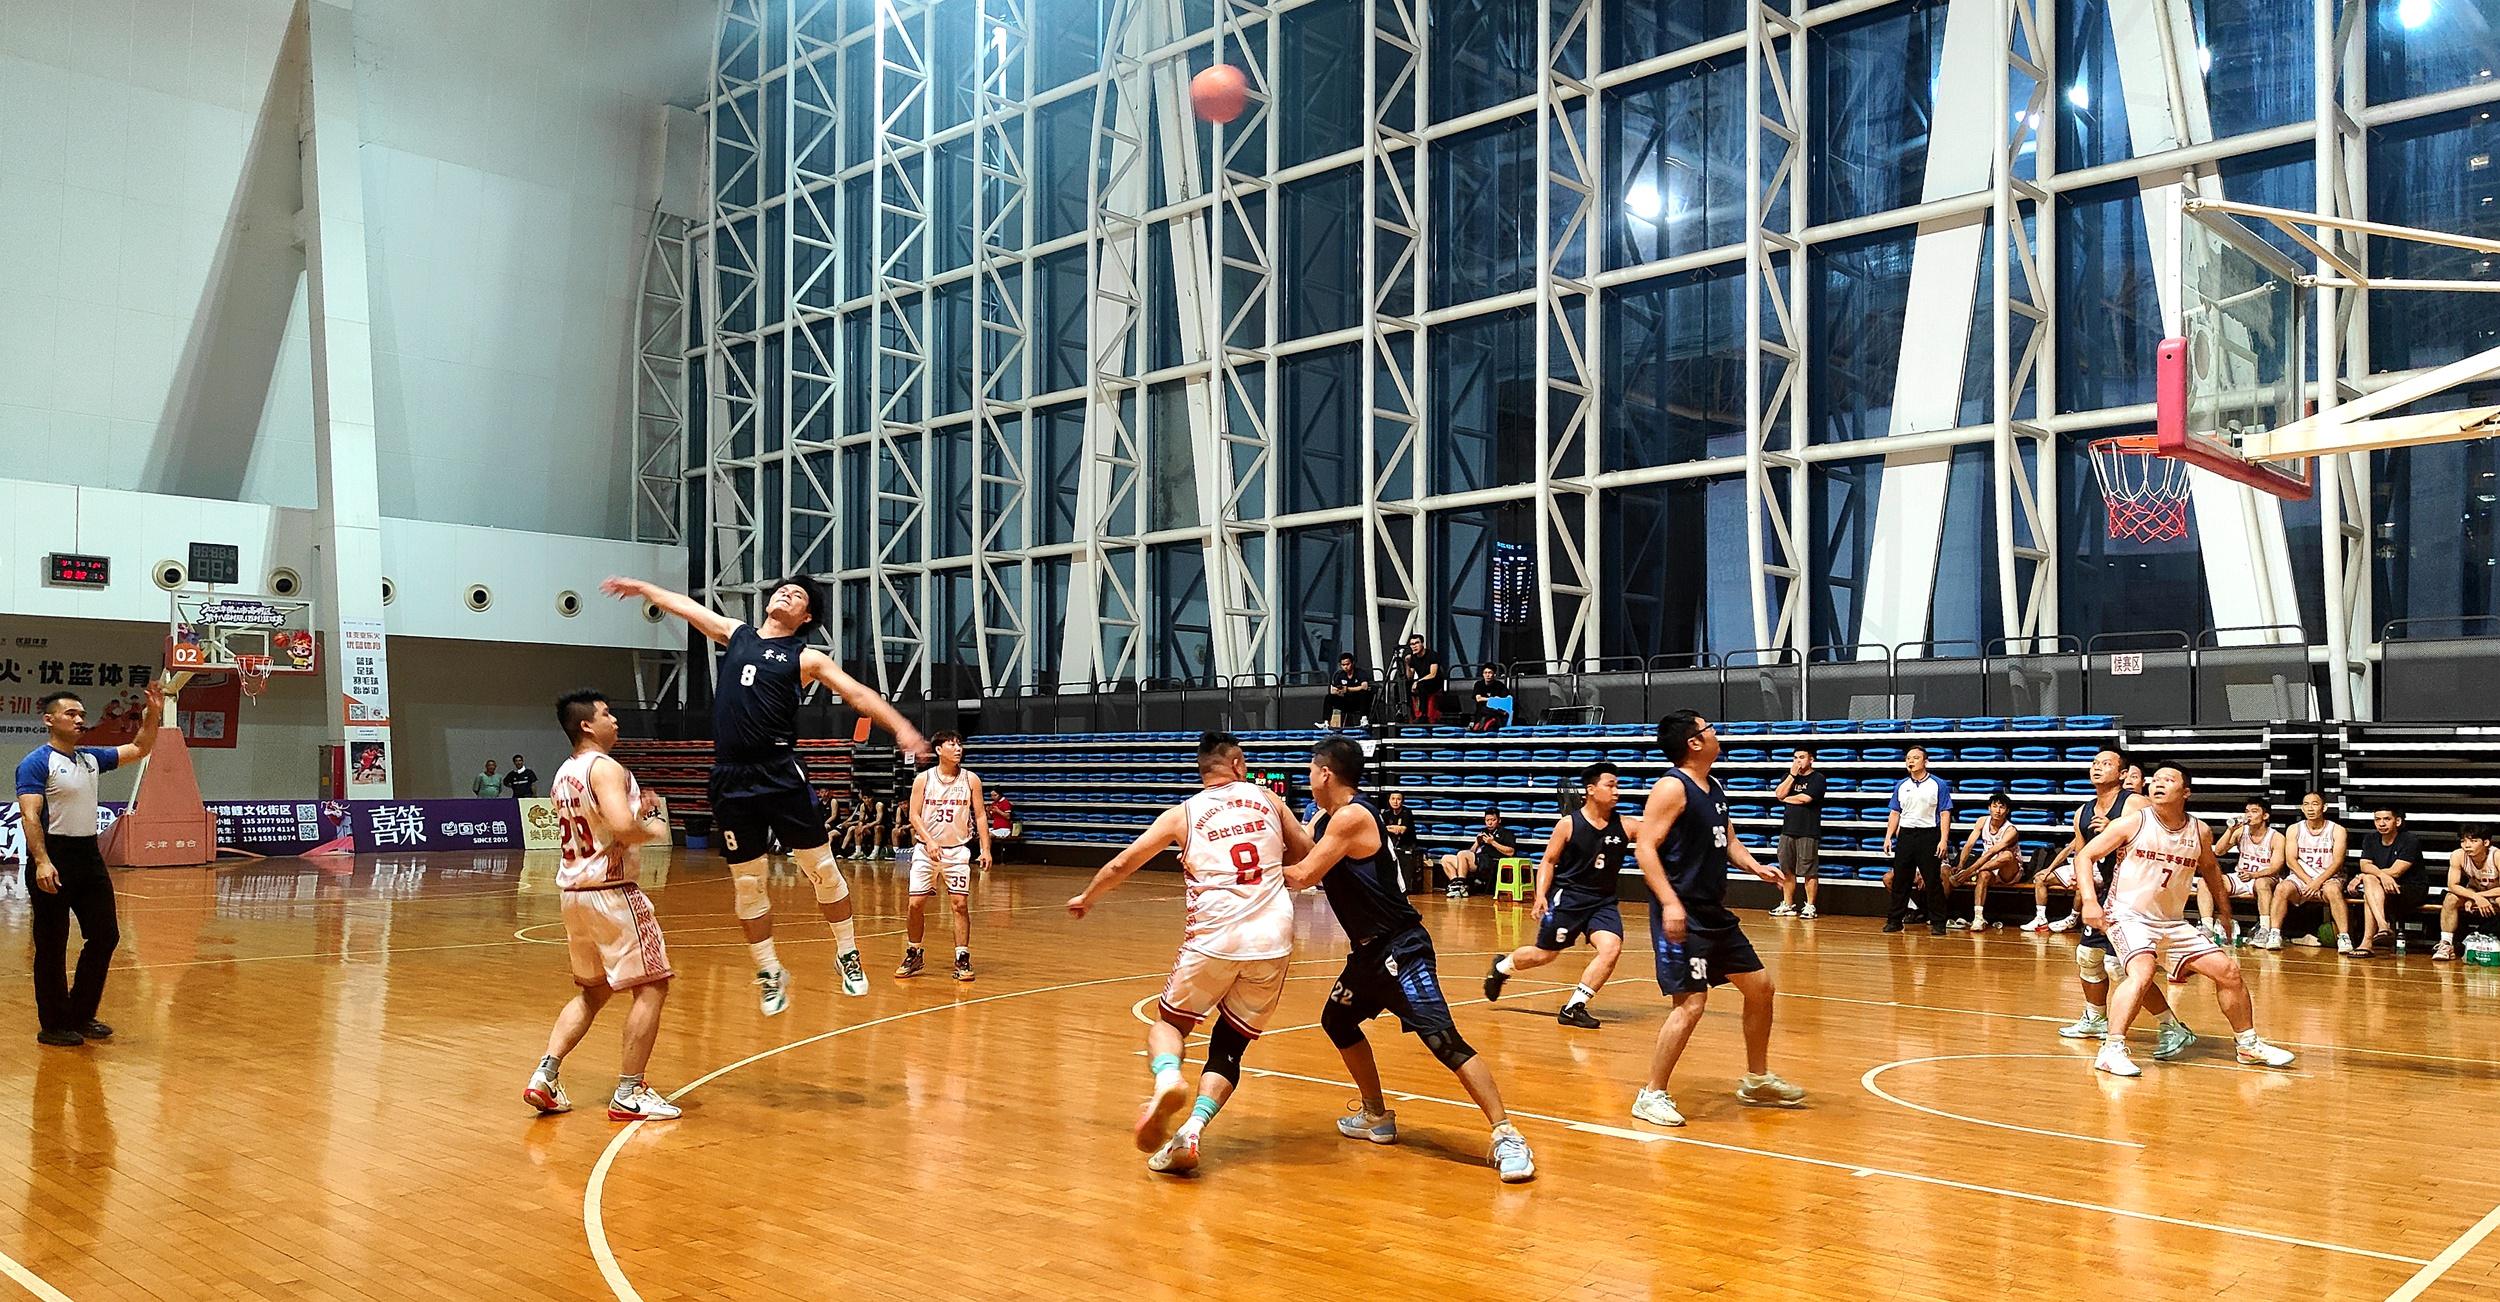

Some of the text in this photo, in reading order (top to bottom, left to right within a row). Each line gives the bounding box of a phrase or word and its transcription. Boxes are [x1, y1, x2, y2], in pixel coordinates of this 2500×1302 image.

[176, 648, 197, 662] 02
[356, 667, 374, 675] 足球
[740, 664, 757, 687] 8
[353, 676, 379, 686] 羽毛球
[353, 687, 379, 695] 跆拳道
[936, 809, 954, 823] 35
[368, 804, 427, 846] 喜策
[724, 830, 739, 851] 8
[1230, 842, 1263, 885] 8
[1594, 853, 1606, 869] 6
[2305, 855, 2324, 868] 24
[951, 876, 967, 888] 35
[2161, 868, 2173, 888] 7
[1330, 981, 1353, 1006] 22
